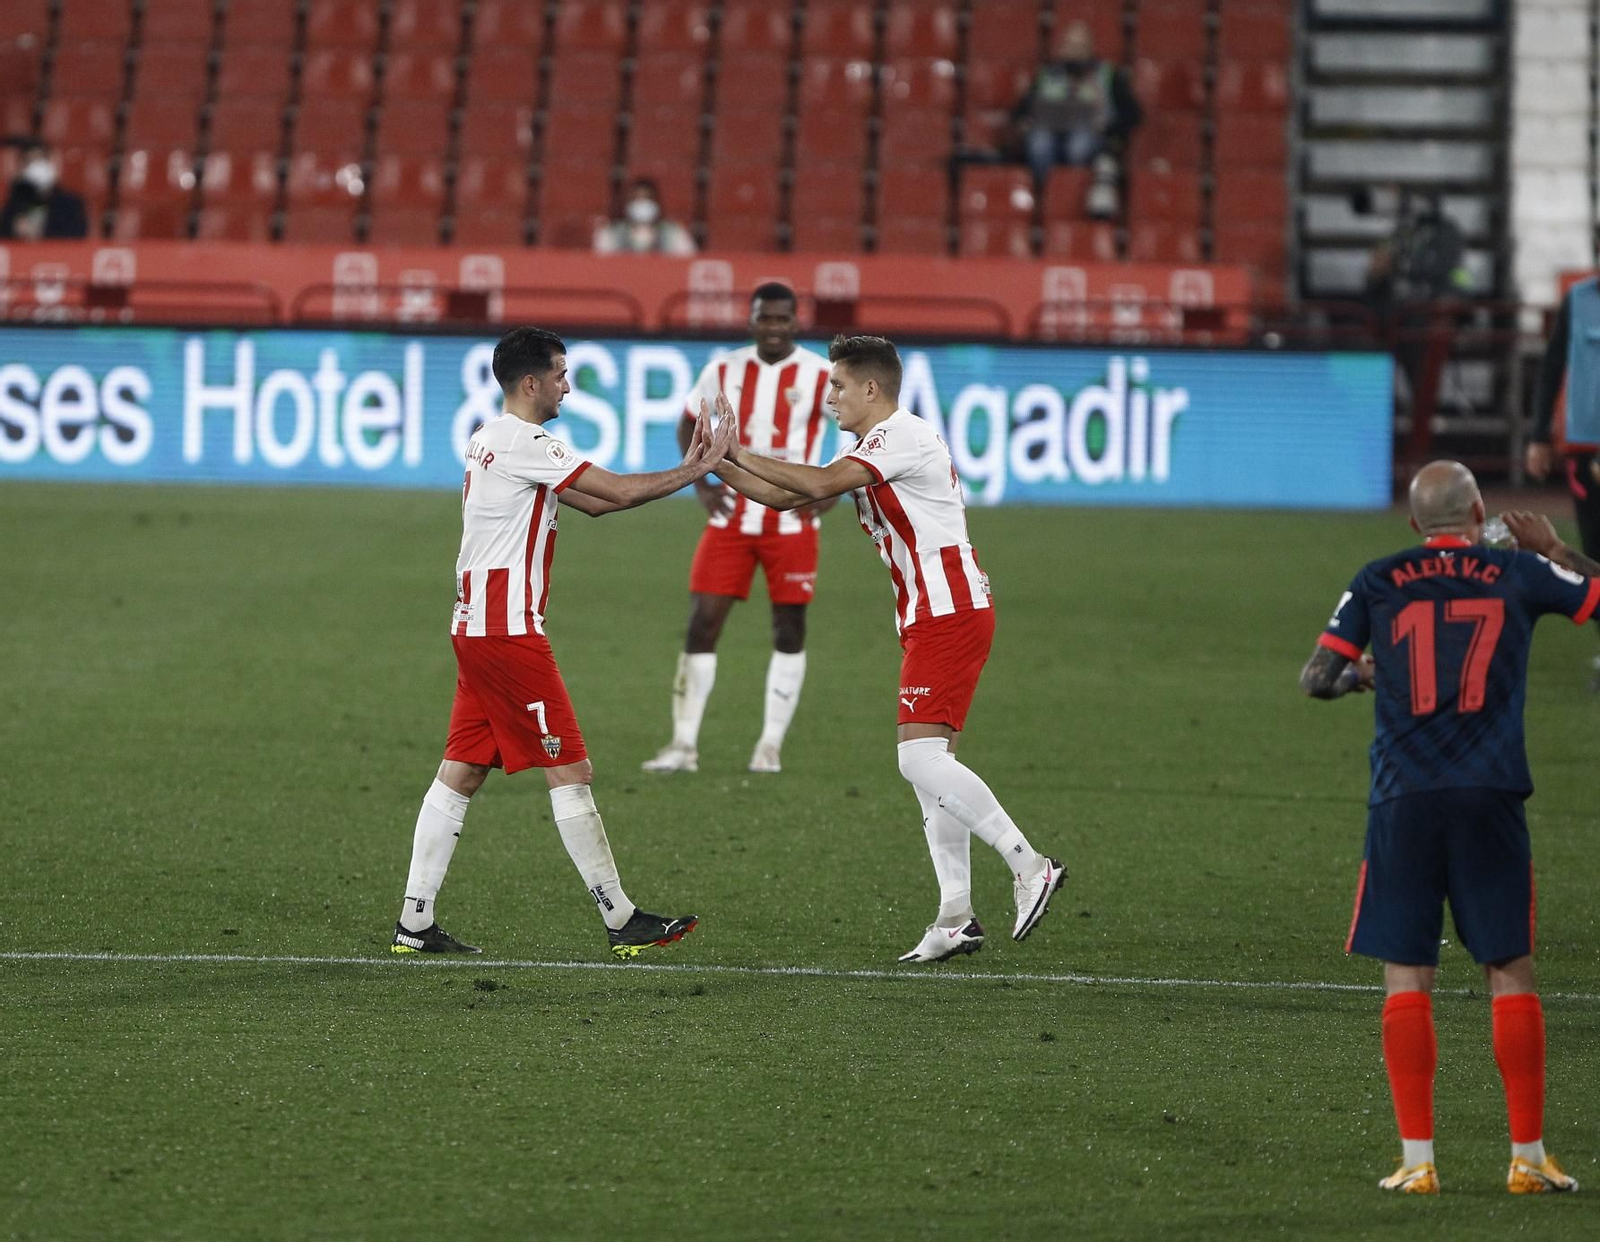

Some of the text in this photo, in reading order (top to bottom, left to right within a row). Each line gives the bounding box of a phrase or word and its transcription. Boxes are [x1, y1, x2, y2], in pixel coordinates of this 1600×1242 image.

[0, 363, 153, 466] ses
[183, 338, 424, 470] Hotel
[555, 341, 730, 471] SP
[1391, 557, 1501, 588] ALEIX V.C
[1392, 598, 1505, 716] 17
[526, 700, 549, 735] 7
